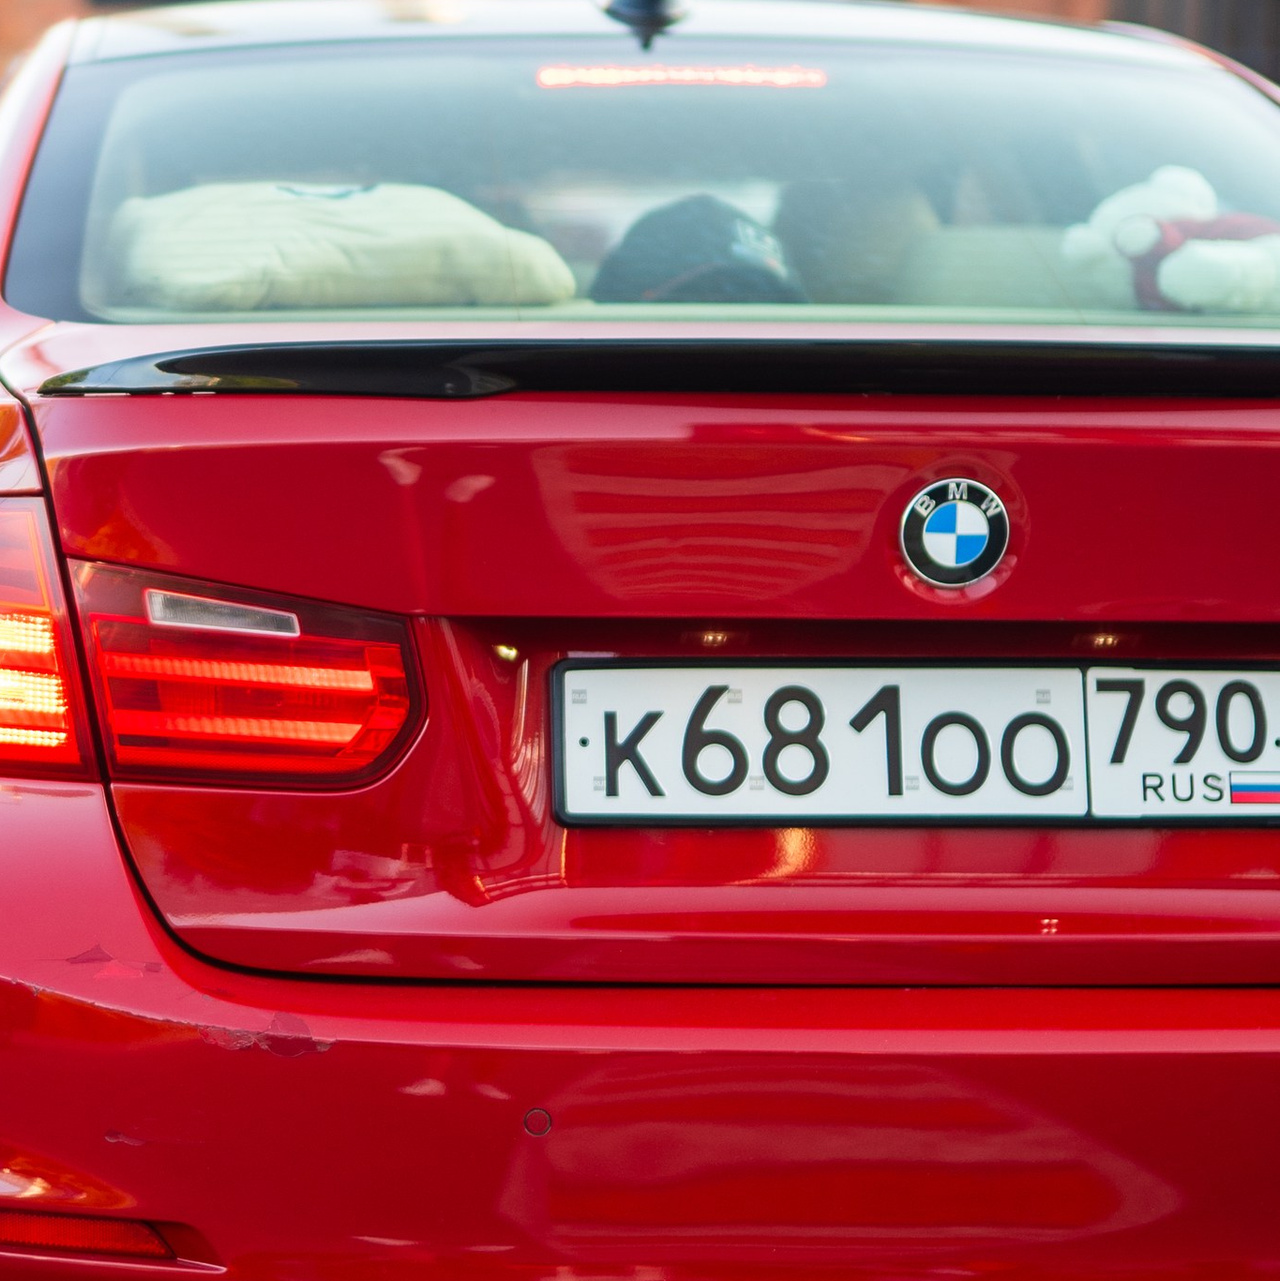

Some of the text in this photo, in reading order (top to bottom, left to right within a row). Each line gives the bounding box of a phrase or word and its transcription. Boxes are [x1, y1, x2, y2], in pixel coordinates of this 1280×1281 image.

[914, 482, 1002, 517] BMW
[1096, 678, 1267, 764] 790
[1142, 773, 1224, 802] RUS
